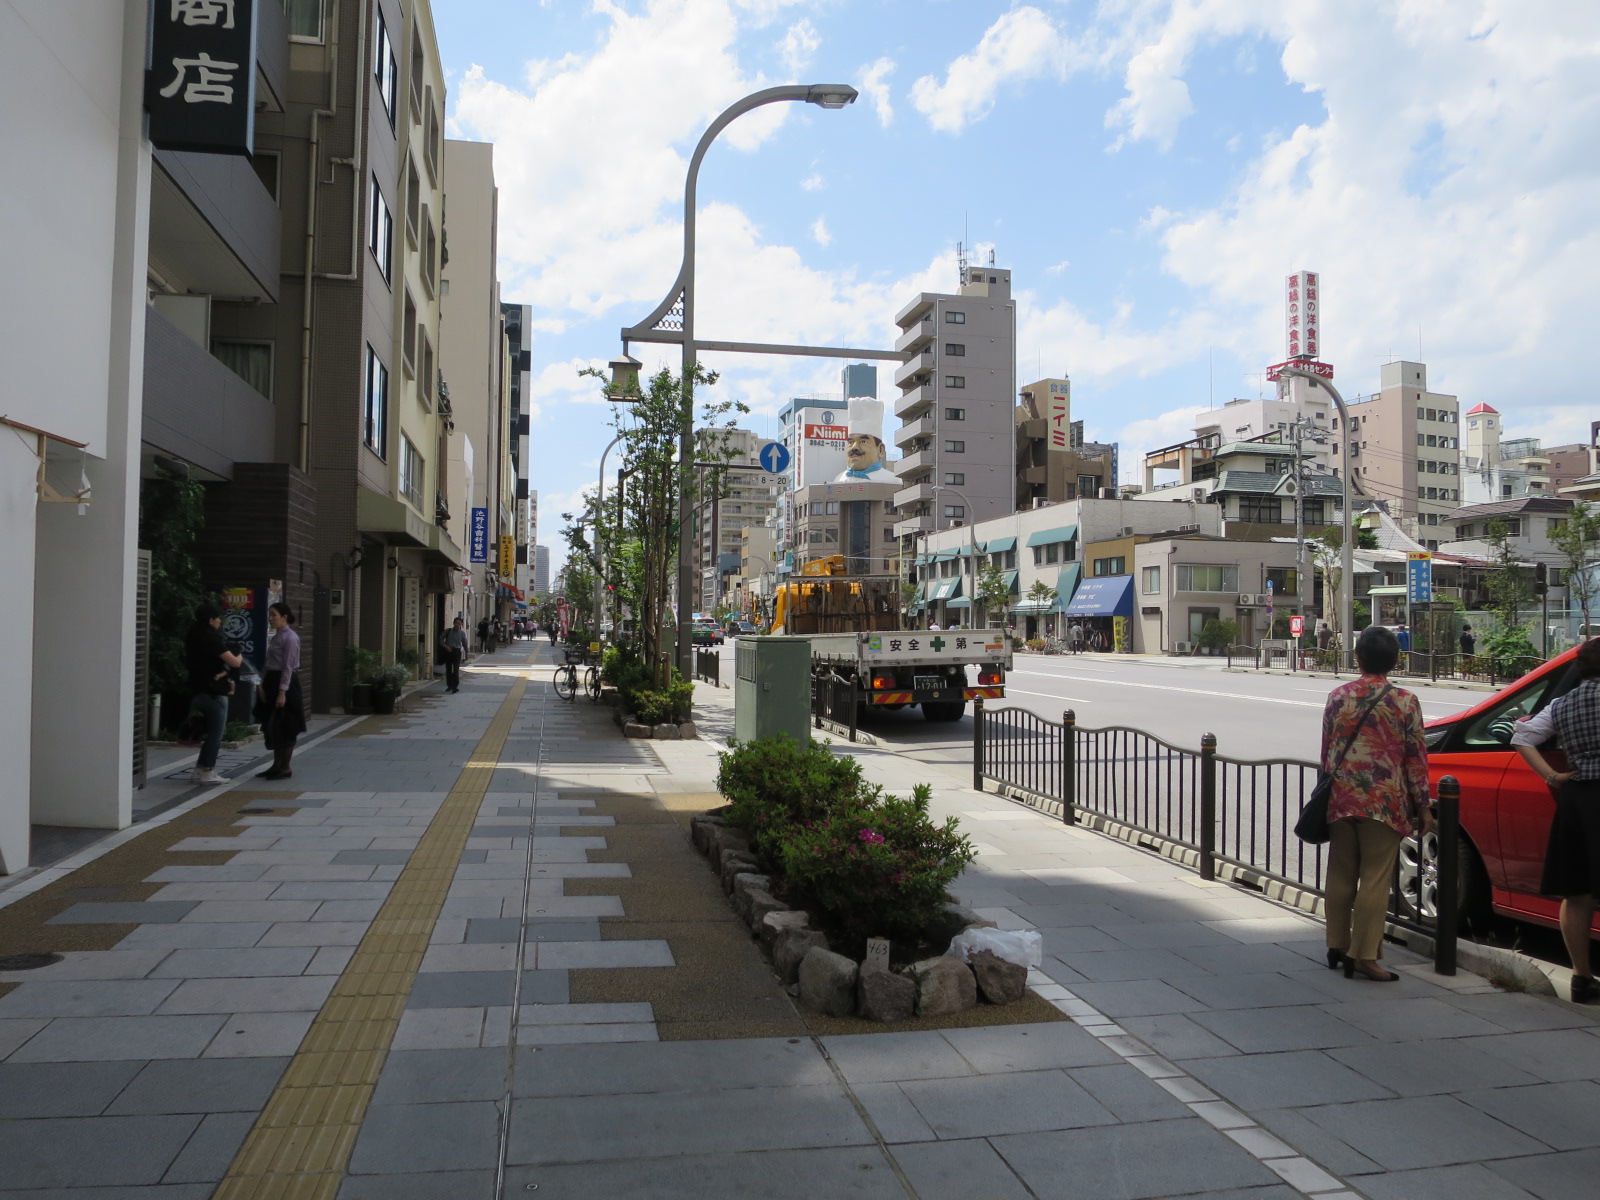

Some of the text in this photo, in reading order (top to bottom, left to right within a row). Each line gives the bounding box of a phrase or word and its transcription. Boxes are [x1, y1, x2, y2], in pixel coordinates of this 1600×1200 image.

[1050, 382, 1068, 394] 食器
[1053, 395, 1066, 447] ニイミ
[810, 426, 847, 441] Niimi
[1421, 561, 1429, 602] 東本願寺
[890, 639, 920, 652] 安全
[955, 637, 985, 652] 第一
